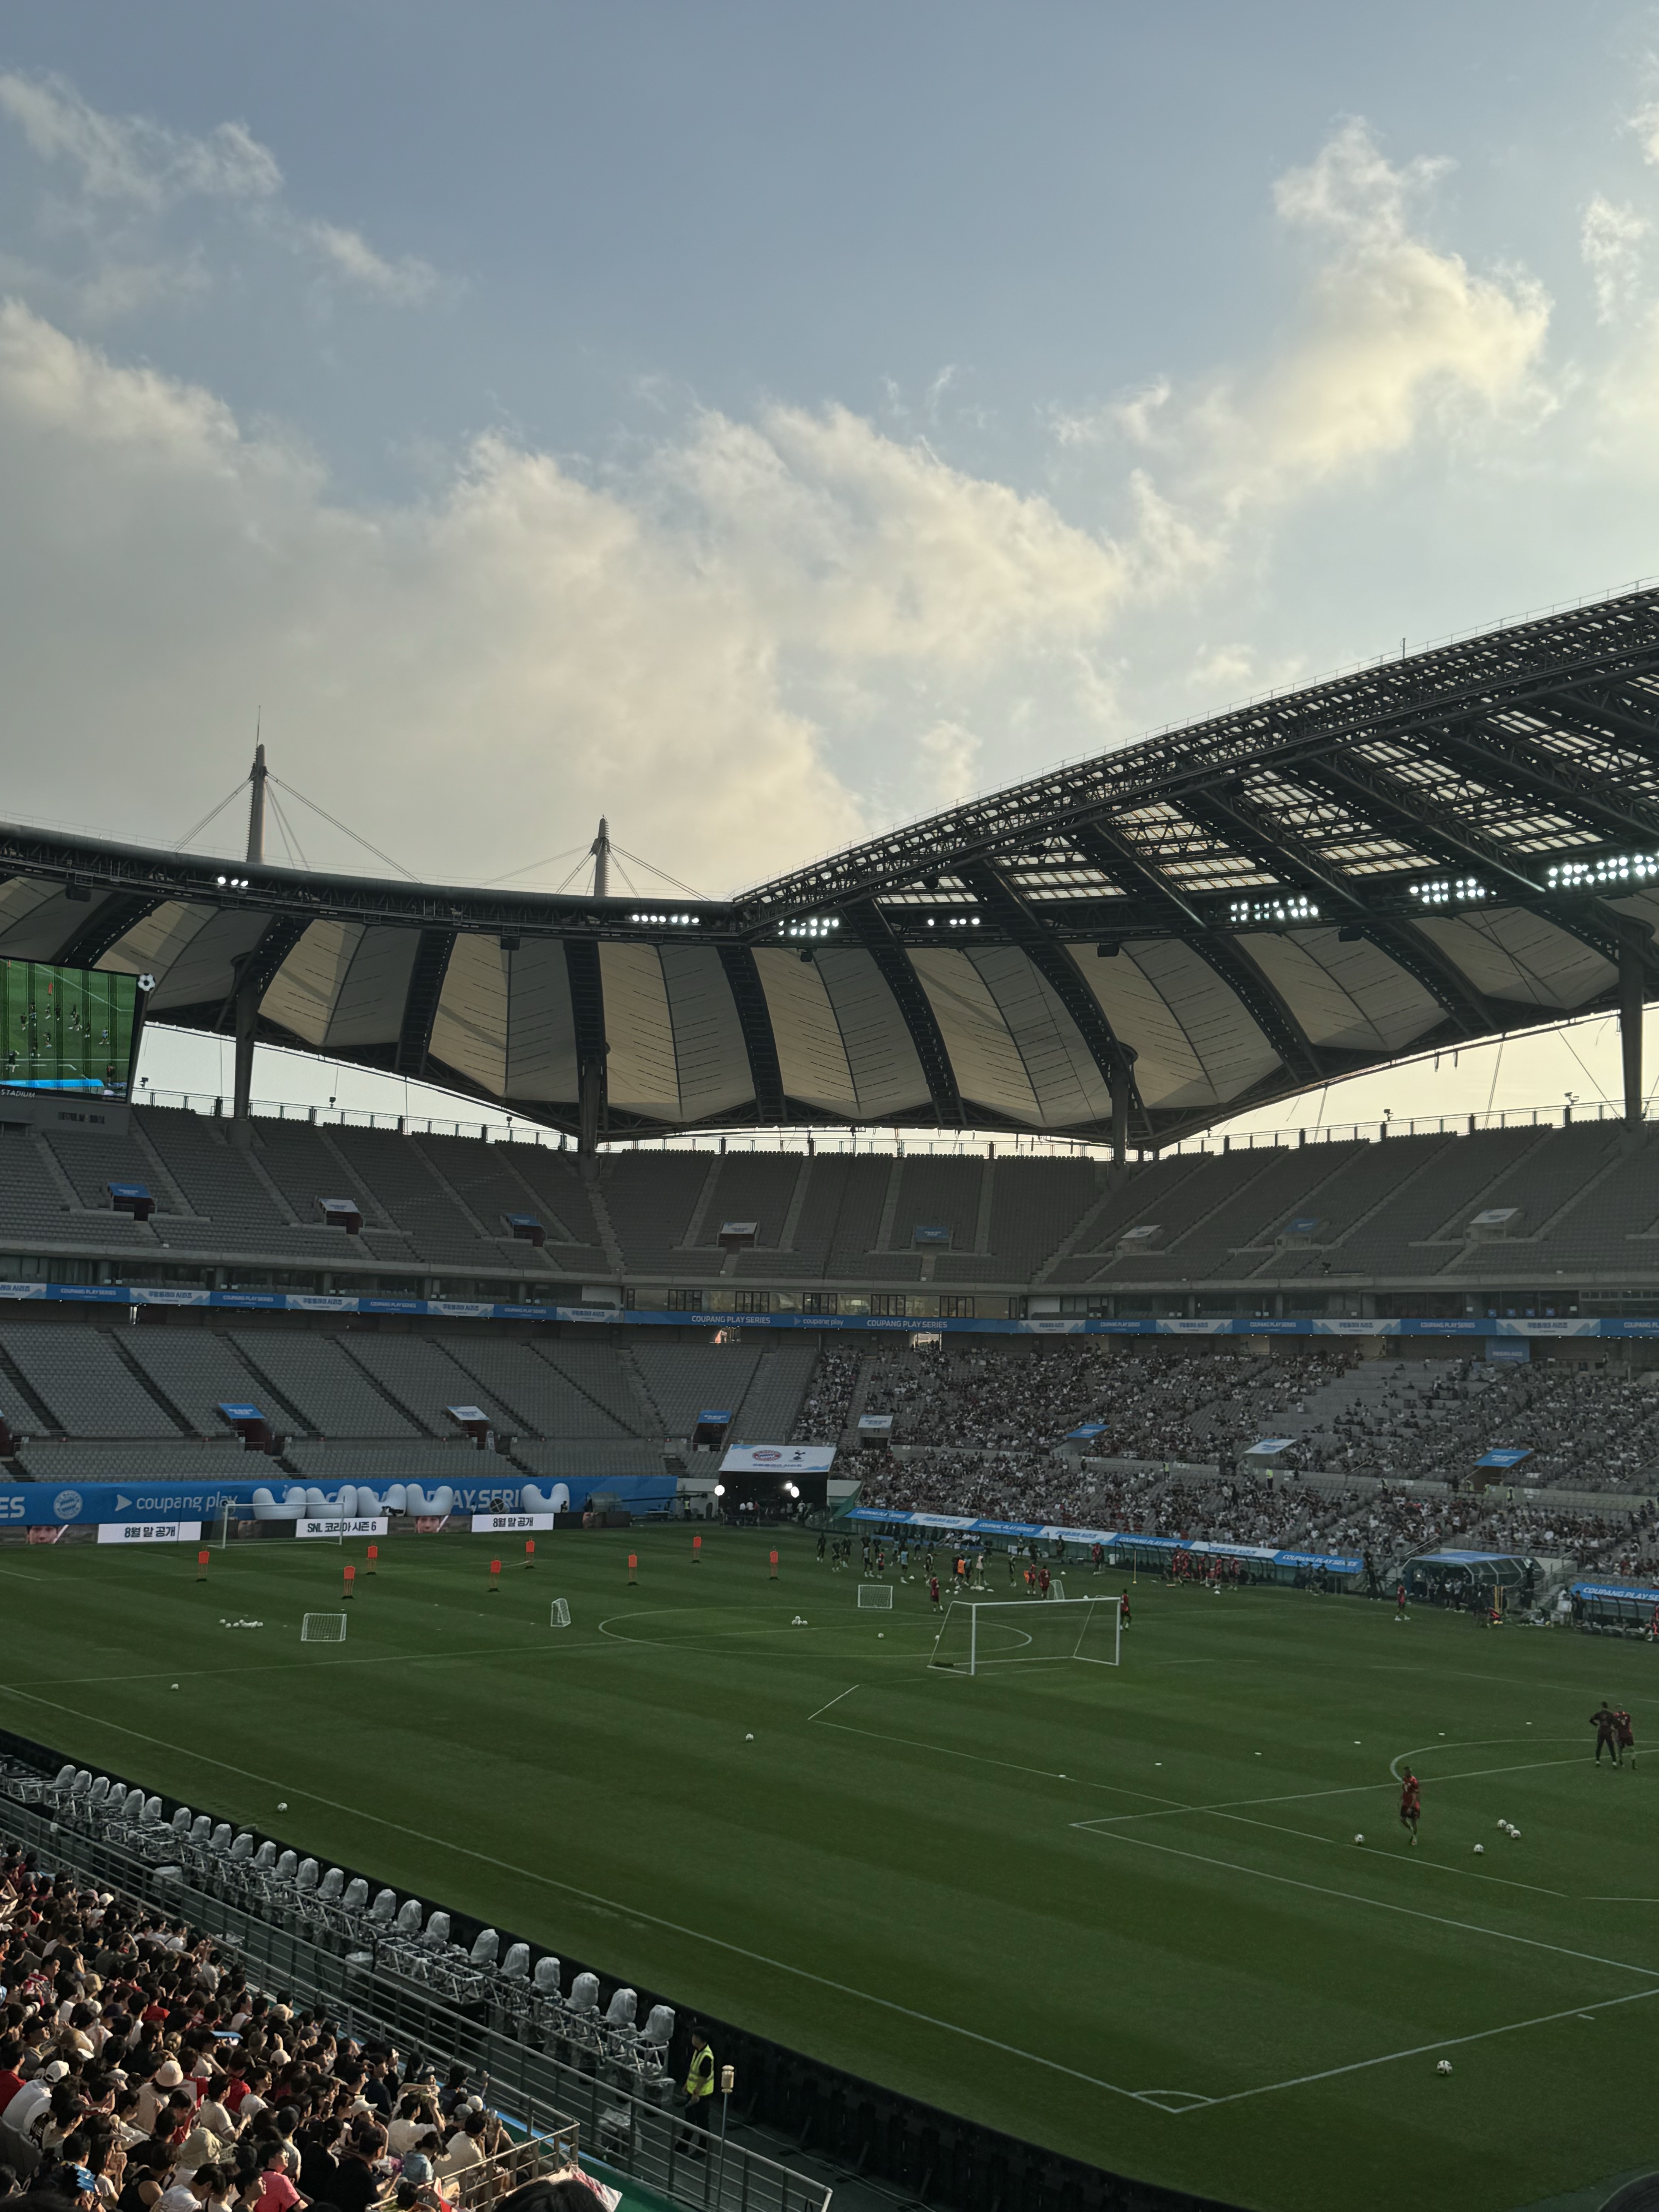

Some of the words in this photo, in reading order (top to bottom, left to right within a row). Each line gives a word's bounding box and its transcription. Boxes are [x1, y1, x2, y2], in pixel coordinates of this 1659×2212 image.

[1, 1089, 36, 1098] STADIUM
[831, 1318, 844, 1326] play
[136, 1496, 203, 1513] coupang
[307, 1523, 323, 1533] SNL
[325, 1522, 350, 1532] 코리아
[352, 1522, 369, 1531] 시즌
[371, 1521, 376, 1531] 6
[493, 1518, 506, 1528] 8월
[508, 1517, 516, 1527] 말
[518, 1517, 533, 1527] 공개
[124, 1527, 141, 1538] 8월
[143, 1527, 153, 1537] 말
[156, 1526, 175, 1537] 공개
[1583, 1587, 1625, 1597] COUPANG
